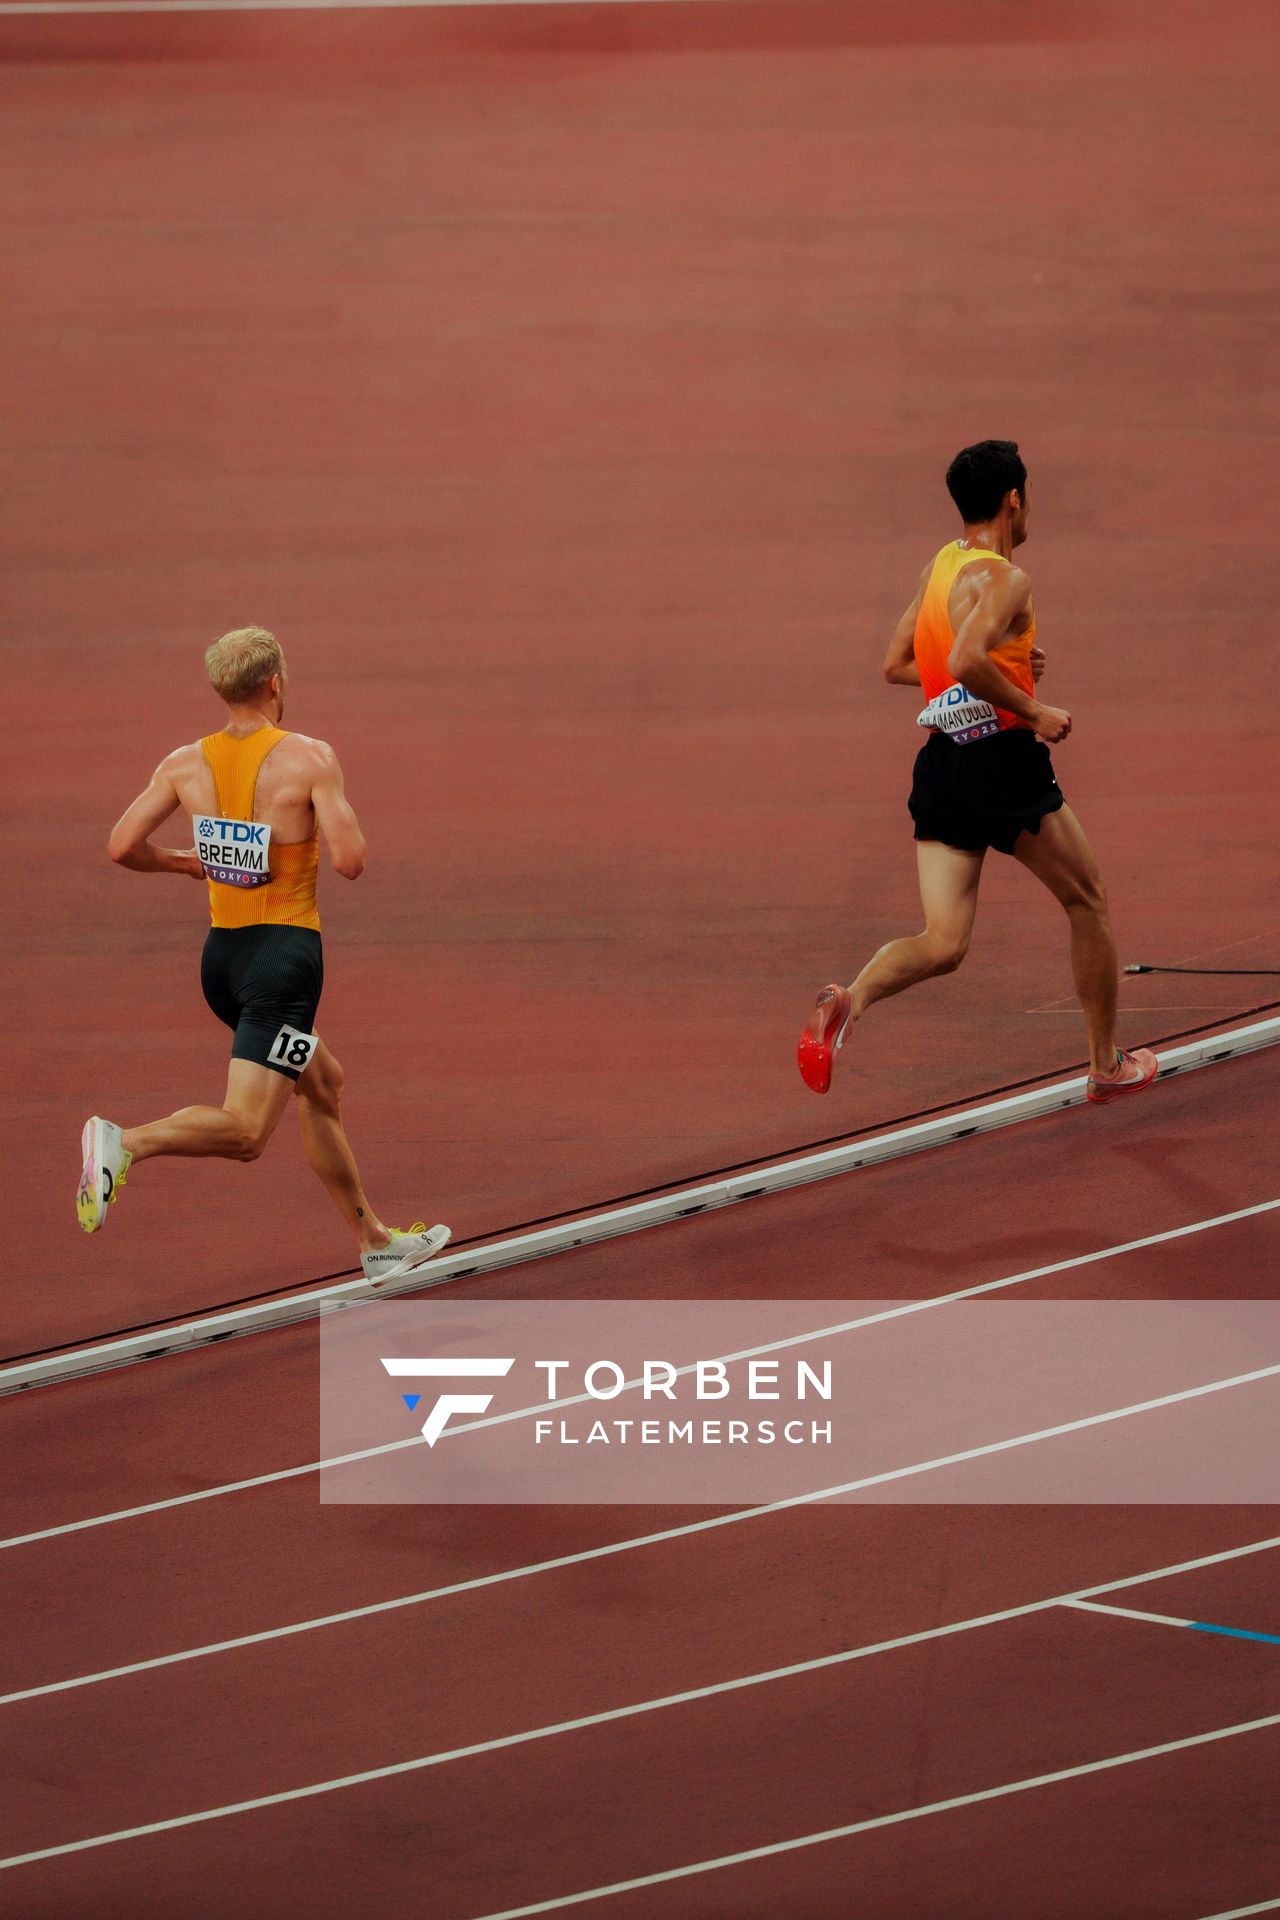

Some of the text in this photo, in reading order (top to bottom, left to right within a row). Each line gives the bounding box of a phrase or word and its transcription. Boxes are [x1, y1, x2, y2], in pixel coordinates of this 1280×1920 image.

[214, 820, 266, 846] TDK
[199, 842, 263, 870] BREMM
[276, 1032, 311, 1066] 18
